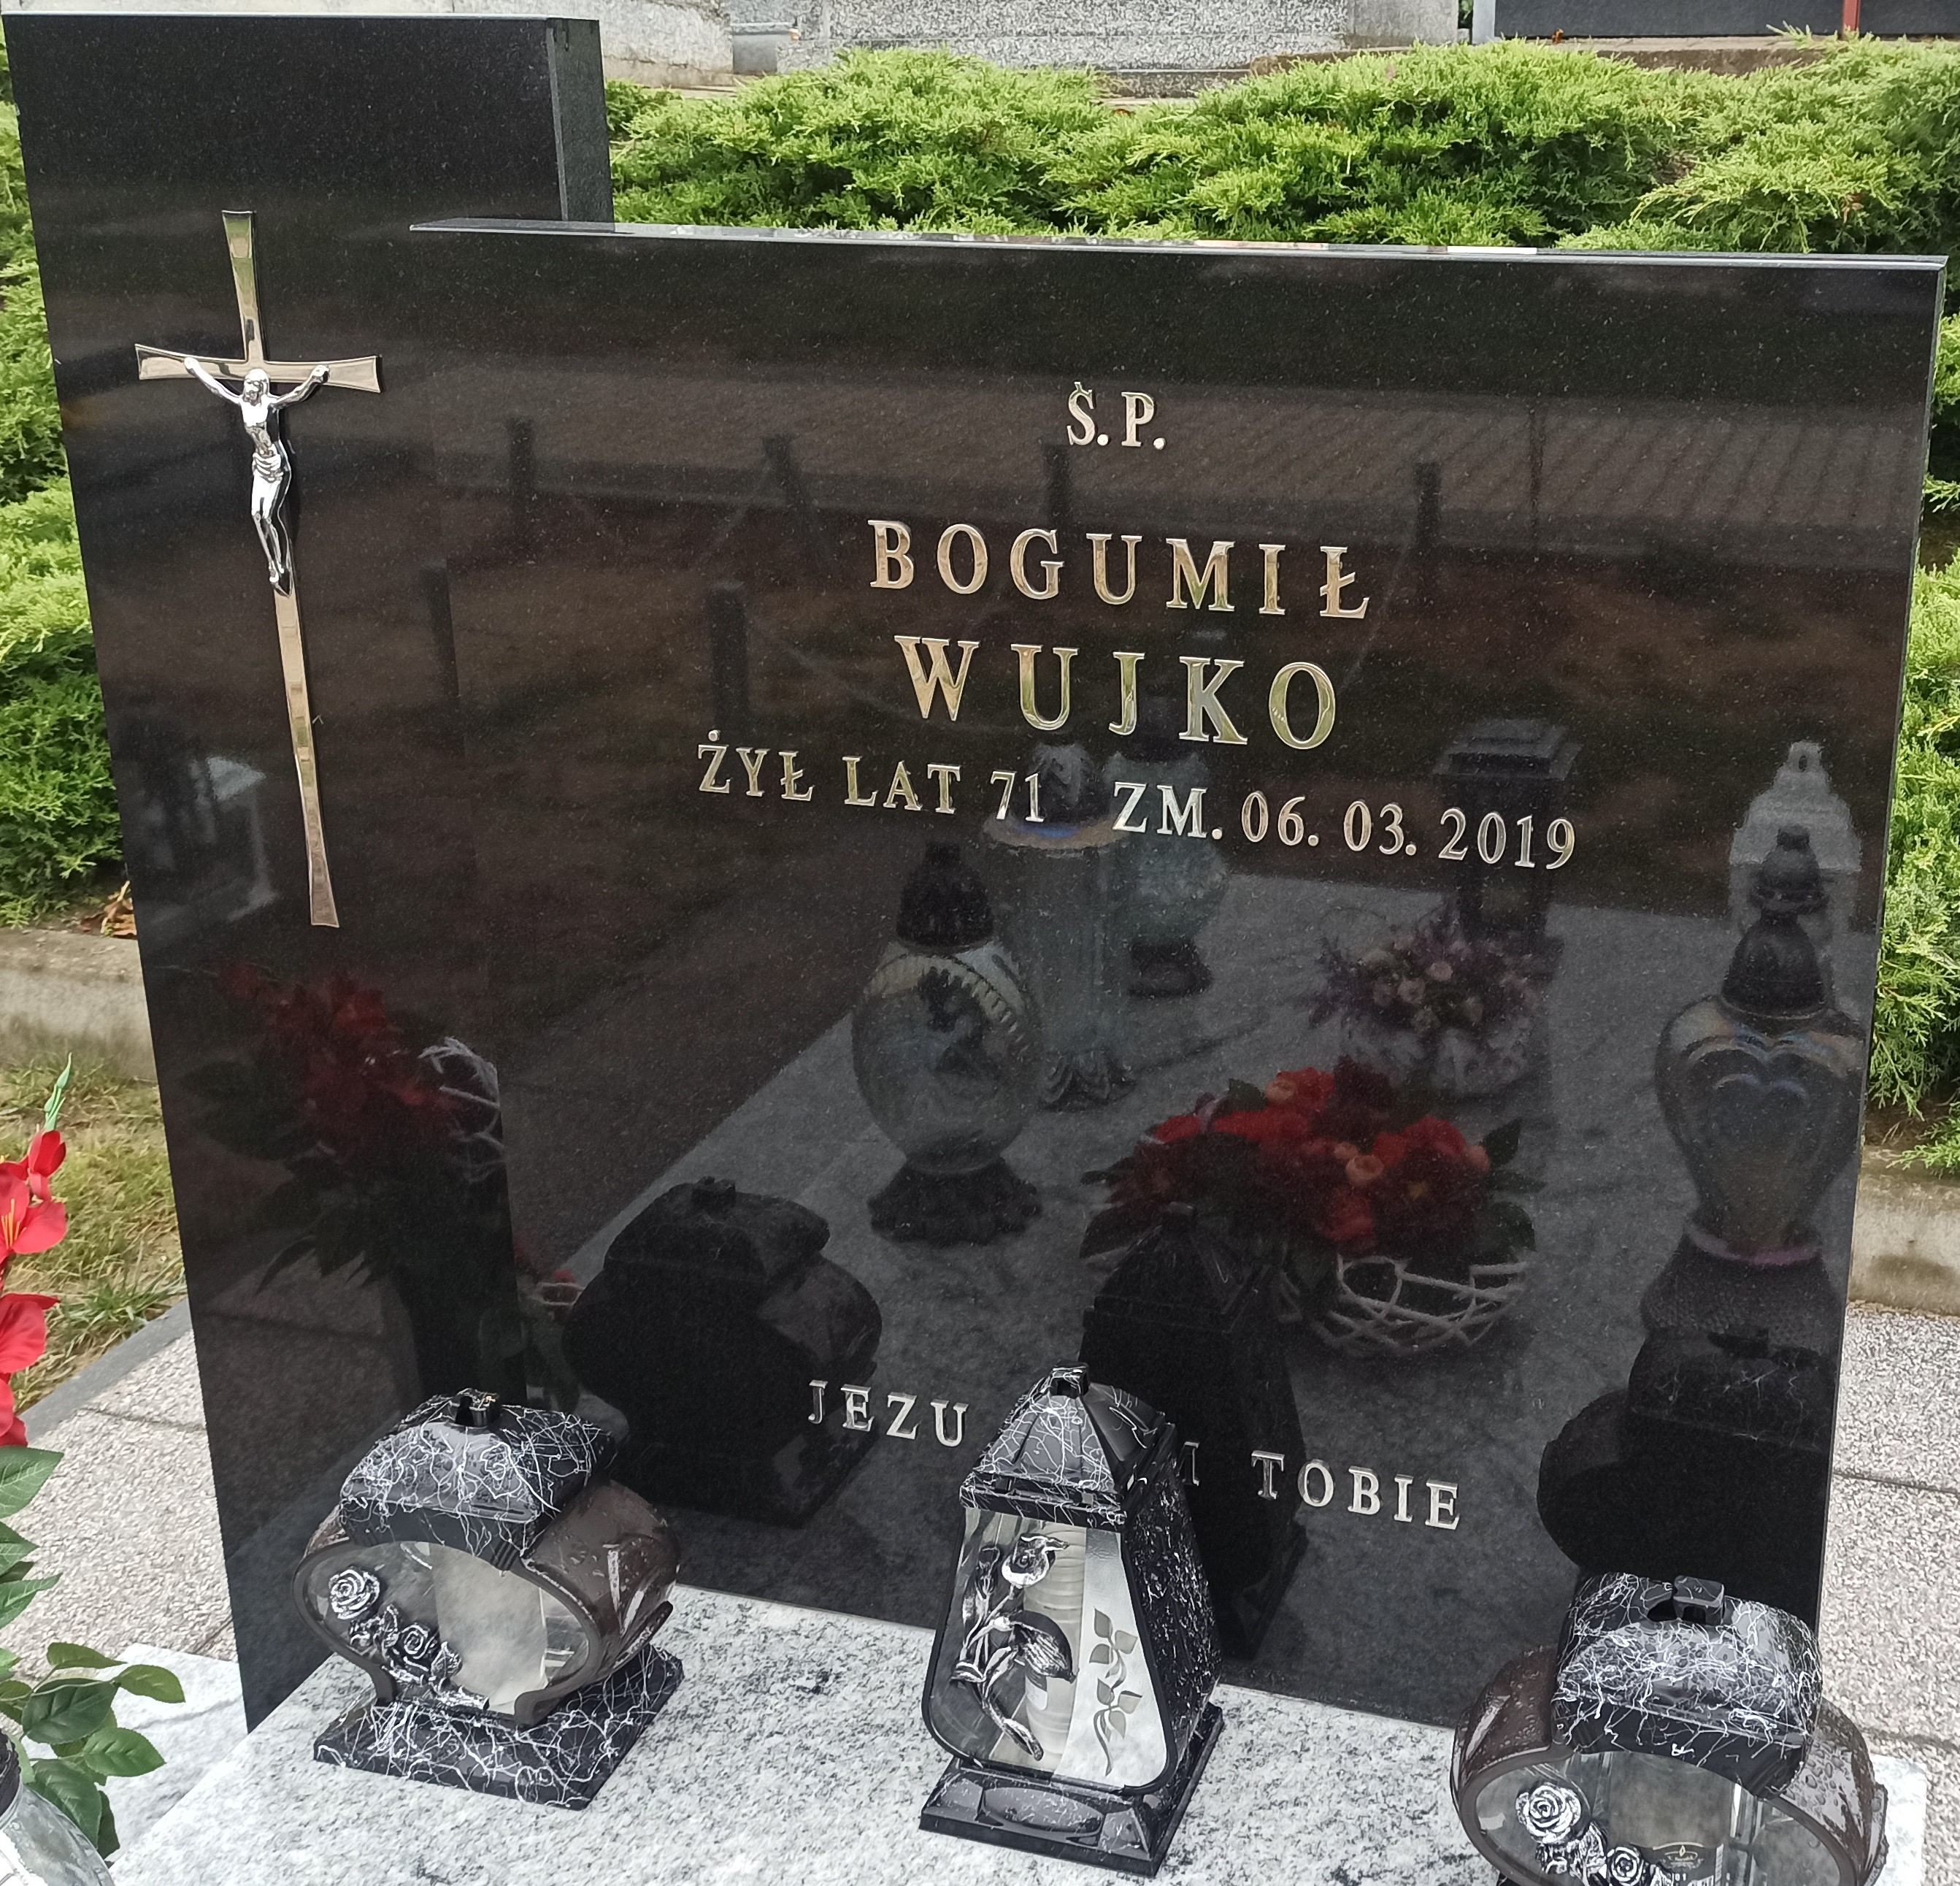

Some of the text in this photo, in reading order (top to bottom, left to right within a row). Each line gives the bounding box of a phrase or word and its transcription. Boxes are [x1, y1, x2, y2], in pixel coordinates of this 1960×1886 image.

[868, 520, 1369, 619] BOGUMIŁ
[894, 635, 1336, 749] WUJKO
[698, 730, 1575, 870] ŻYŁ LAT 71 ZM. 06. 03. 2019
[808, 1379, 968, 1447] JEZU
[1251, 1450, 1461, 1530] TOBIE
